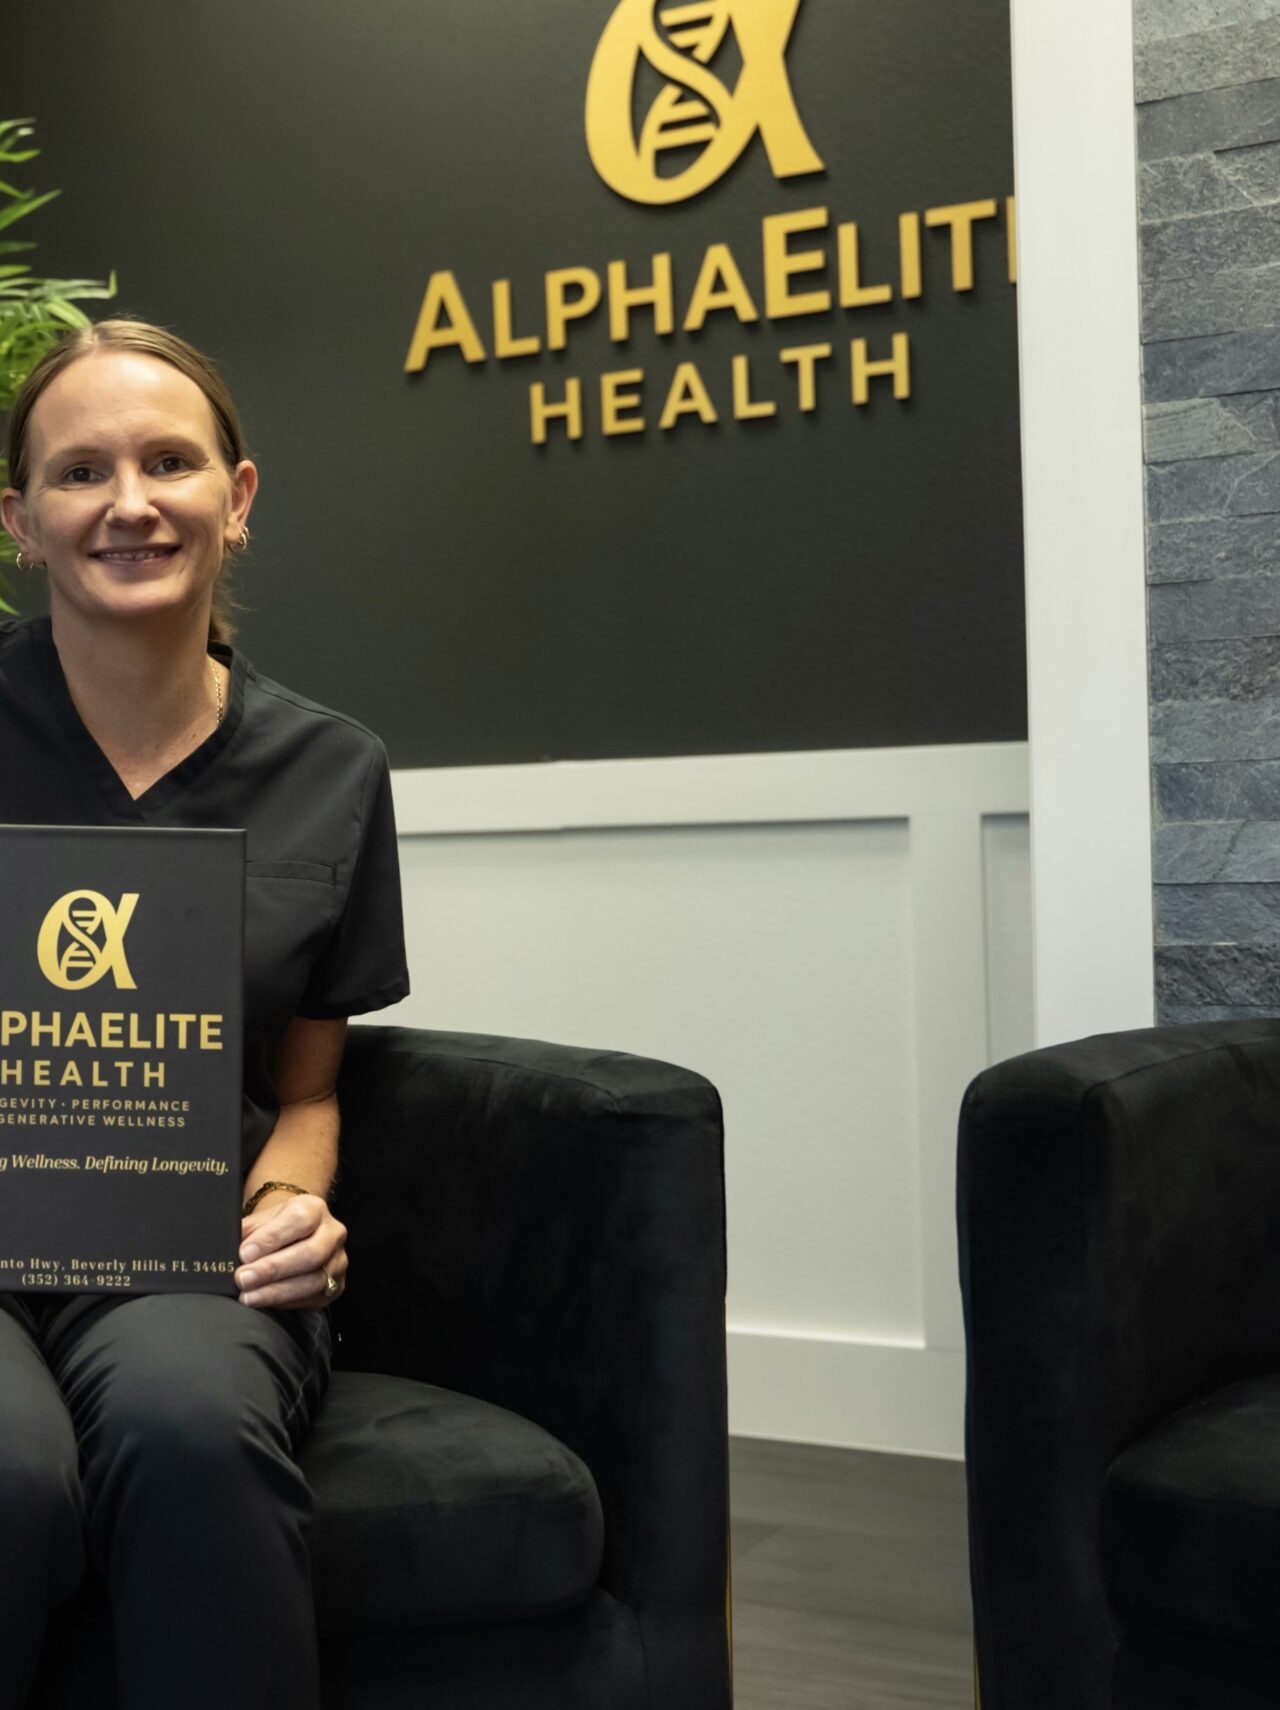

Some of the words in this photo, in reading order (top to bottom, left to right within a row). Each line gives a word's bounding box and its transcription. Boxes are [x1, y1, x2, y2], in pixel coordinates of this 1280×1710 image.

[405, 195, 1017, 372] ALPHAELIT
[529, 332, 910, 445] HEALTH
[1, 1059, 165, 1088] HEALTH
[71, 1099, 190, 1112] PERFORMANCE
[102, 1115, 186, 1128] WELLNESS
[11, 1153, 80, 1170] Wellness.
[84, 1155, 148, 1175] Defining
[151, 1156, 229, 1176] Longevity.
[71, 1258, 127, 1273] Beverly
[132, 1259, 166, 1272] Hills
[171, 1260, 188, 1272] FL
[193, 1261, 235, 1273] 34465
[21, 1273, 59, 1287] (352)
